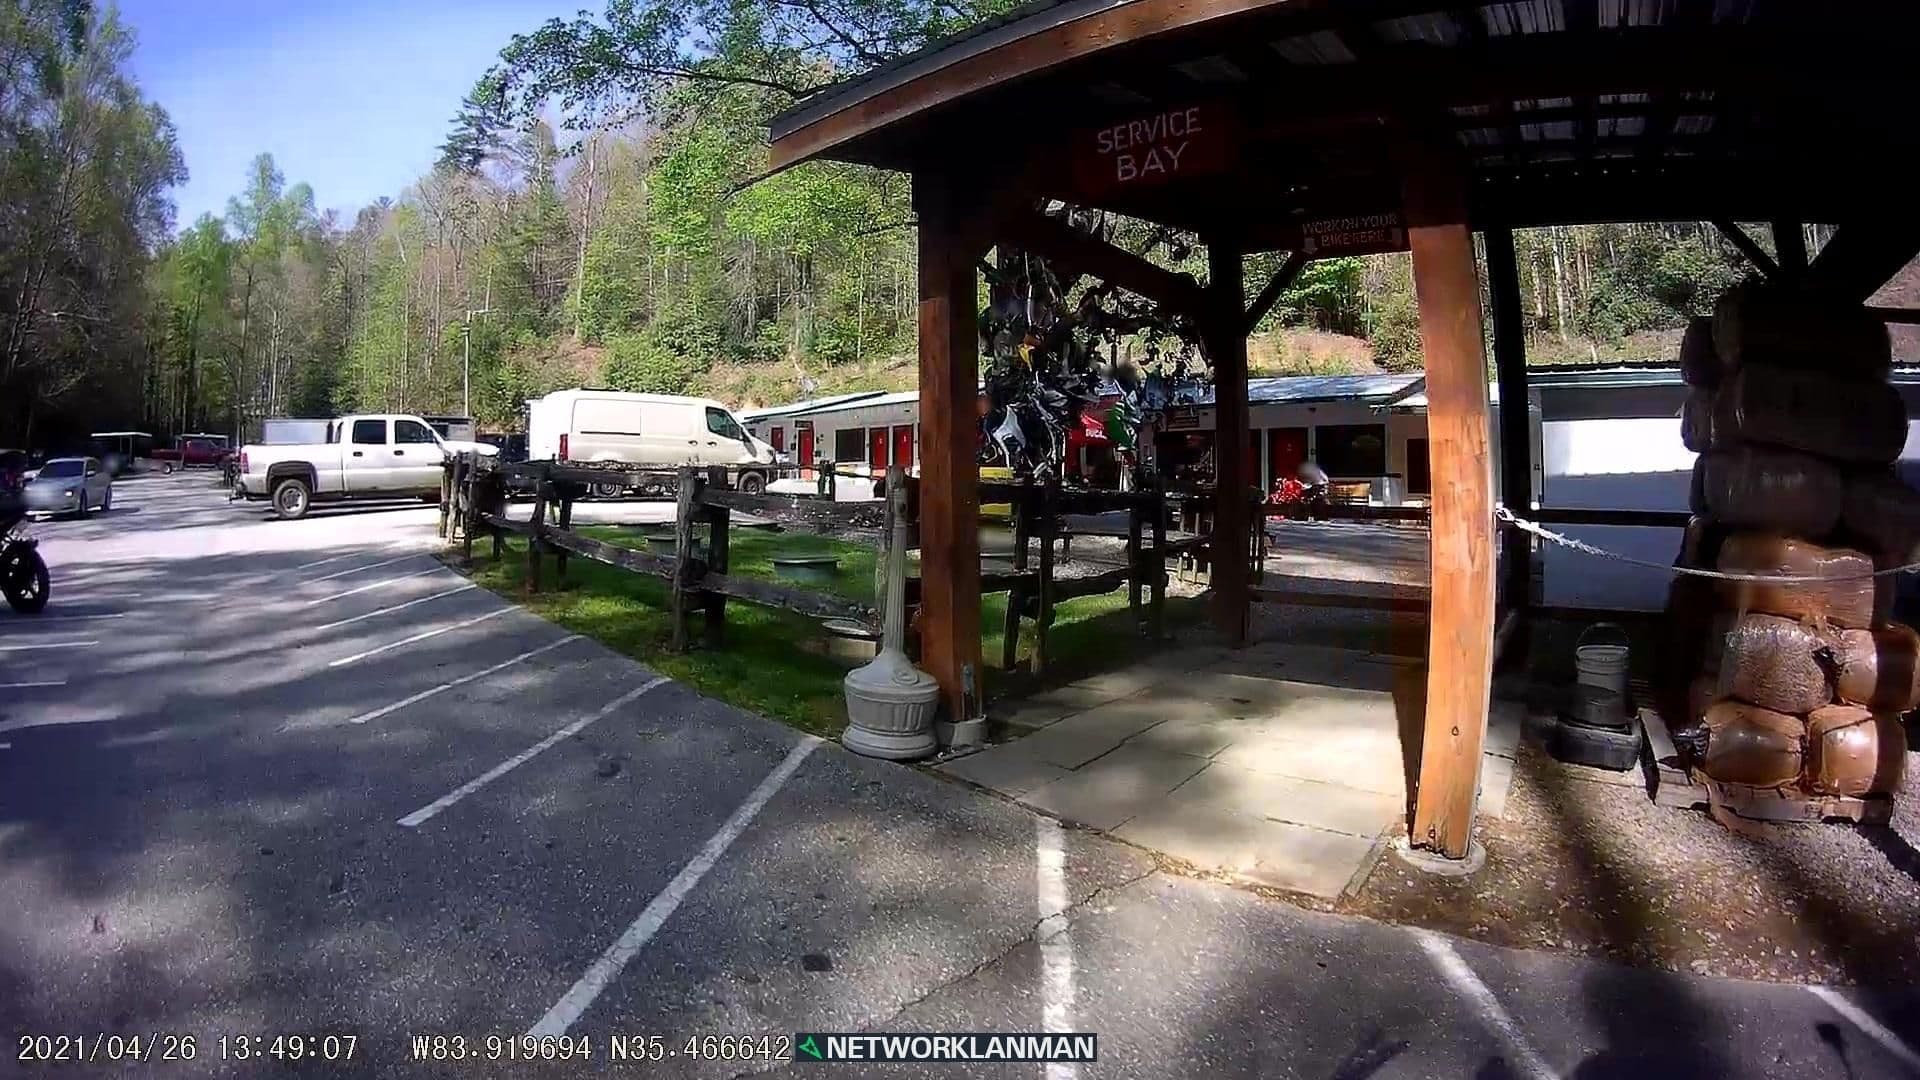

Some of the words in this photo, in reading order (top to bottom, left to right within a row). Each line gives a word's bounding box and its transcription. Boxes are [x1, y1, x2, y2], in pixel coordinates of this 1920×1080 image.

[1096, 106, 1203, 155] SERVICE
[1117, 141, 1190, 182] BAY
[1301, 218, 1341, 234] WORK
[1360, 214, 1399, 229] YOUR
[1321, 232, 1352, 247] BIKE
